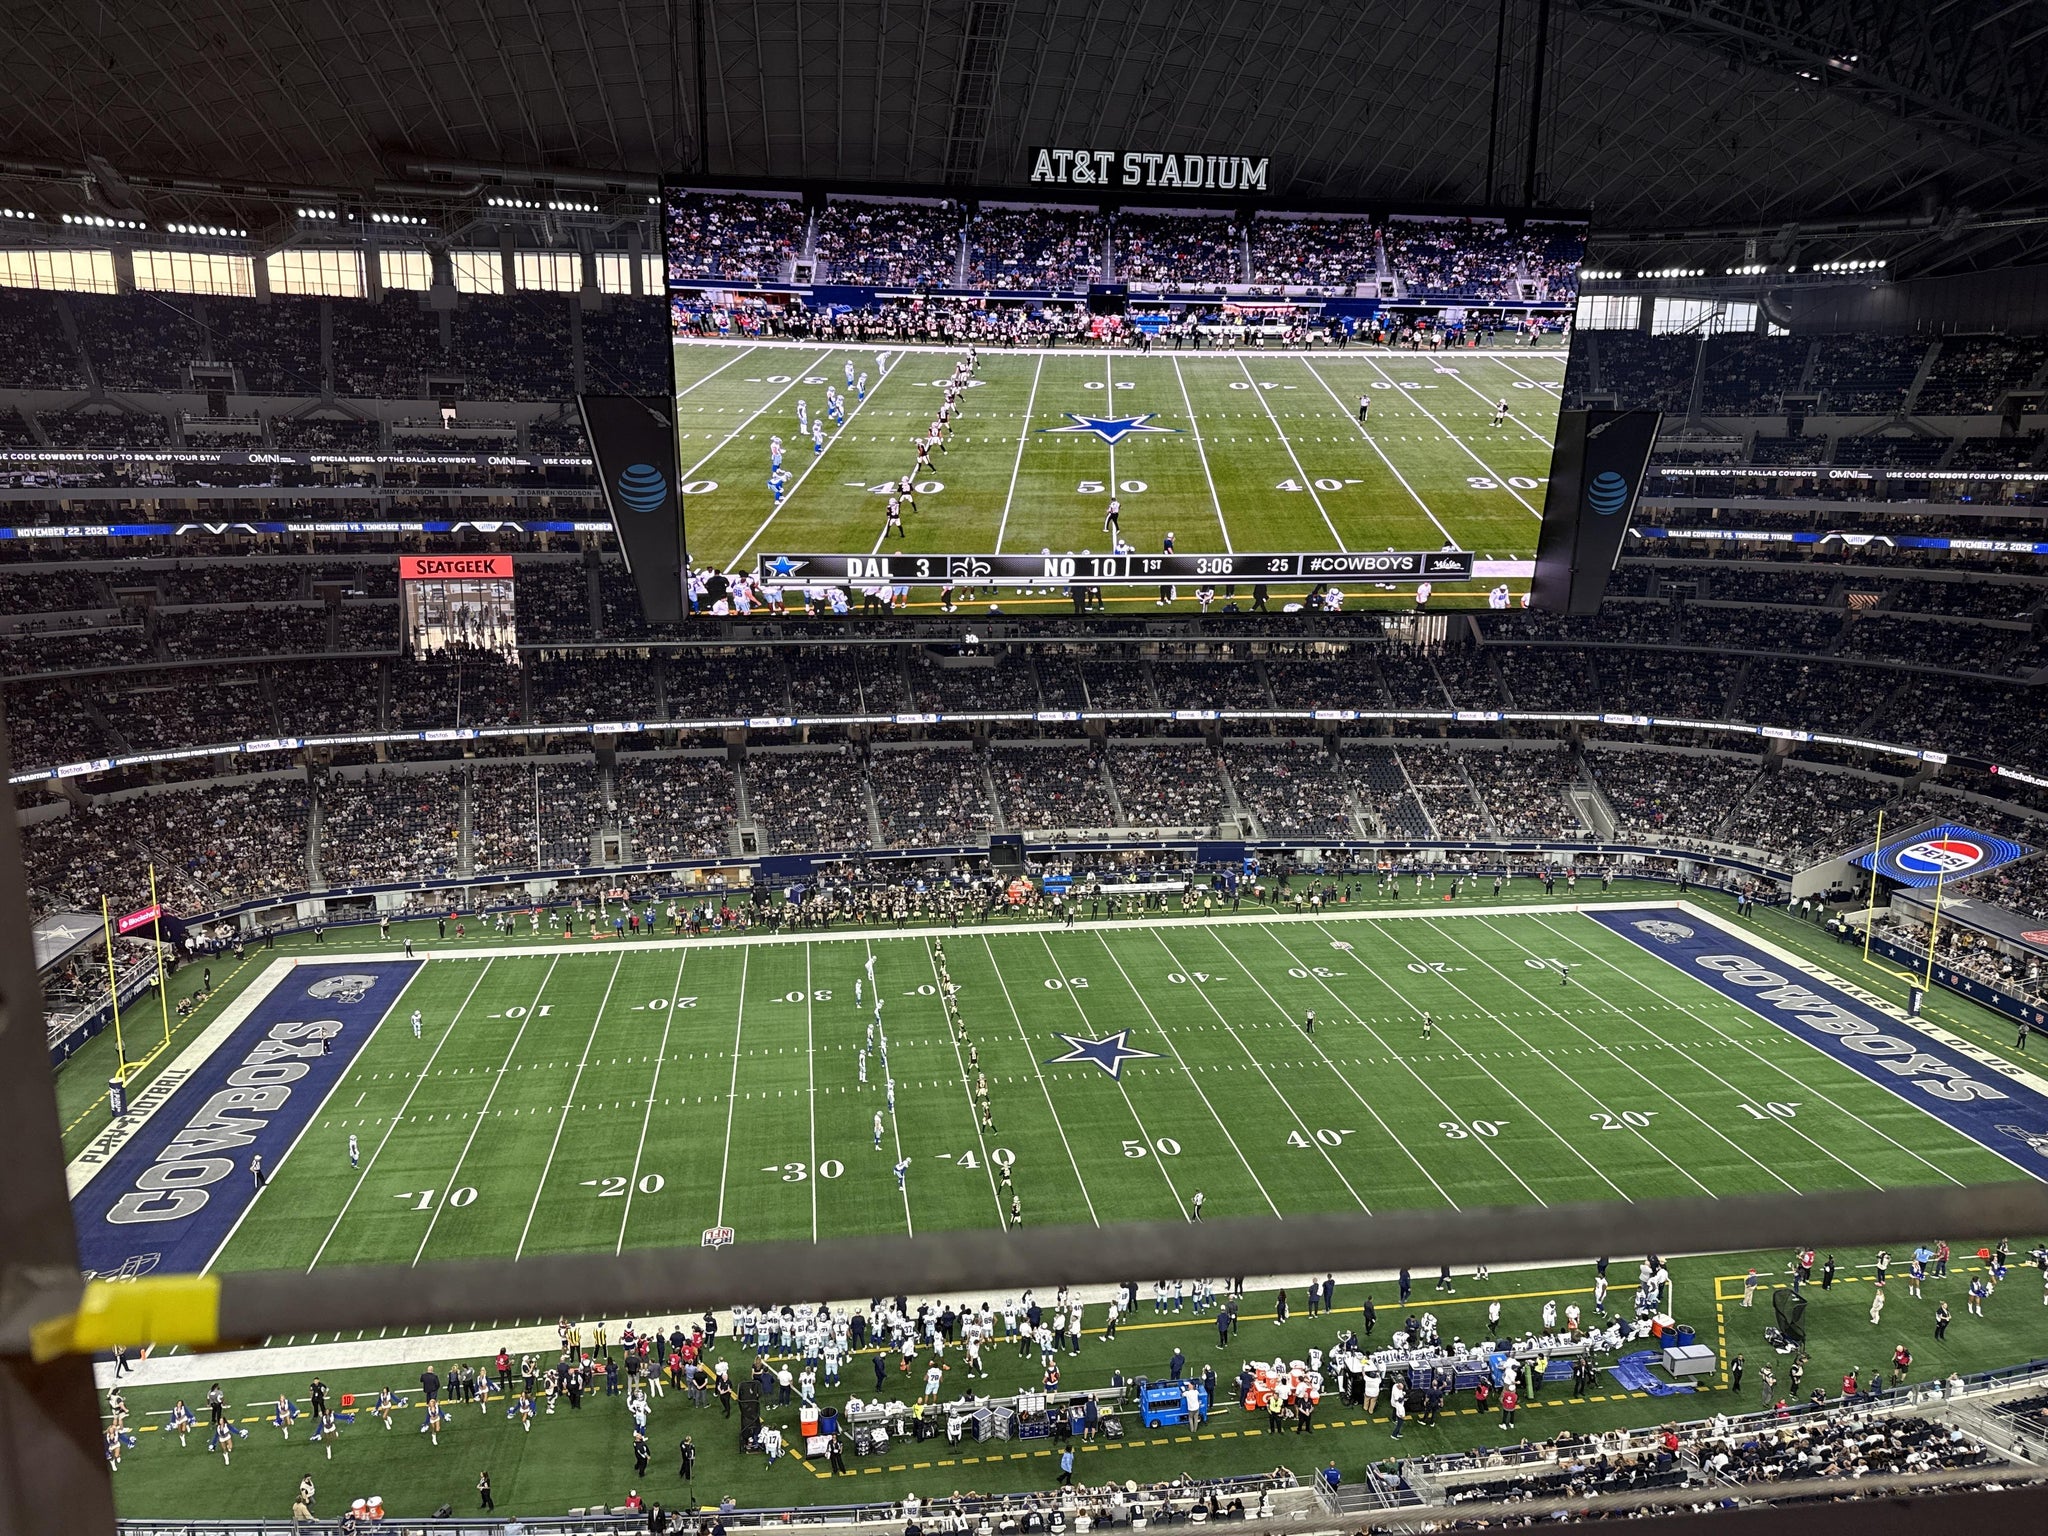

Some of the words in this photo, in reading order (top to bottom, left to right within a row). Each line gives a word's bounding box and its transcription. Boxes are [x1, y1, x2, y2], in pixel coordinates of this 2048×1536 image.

[1030, 149, 1115, 184] AT&T
[1122, 152, 1269, 190] STADIUM
[39, 453, 84, 461] COWBOYS
[249, 454, 279, 463] OMNI
[488, 456, 516, 465] OMNI
[1829, 469, 1858, 479] OMNI
[1077, 480, 1148, 493] 50
[1275, 479, 1343, 491] 40
[1466, 476, 1538, 489] 30
[18, 527, 65, 537] NOVEMBER
[68, 527, 83, 537] 22,
[85, 526, 109, 535] 2026
[574, 522, 613, 531] NOVEMBER
[1950, 540, 1993, 550] NOVEMBER
[1994, 542, 2008, 551] 22,
[416, 559, 497, 574] SEATGEEK
[848, 558, 894, 577] DAL
[916, 559, 930, 577] 3
[1044, 558, 1076, 577] NO
[1090, 559, 1116, 577] 10
[1143, 559, 1162, 574] 1ST
[1197, 558, 1233, 574] 3:06
[1267, 558, 1289, 572] :25
[1310, 557, 1413, 572] #COWBOYS
[60, 766, 83, 775] Tostitos
[1911, 845, 1970, 868] PEPSI
[1288, 966, 1334, 978] 30
[1407, 962, 1455, 974] 20
[1044, 977, 1089, 990] 50
[1167, 971, 1210, 984] 40
[648, 996, 698, 1011] 20
[785, 989, 833, 1003] 30
[505, 1004, 555, 1019] 10
[1799, 965, 1826, 976] IT
[1828, 977, 1894, 1010] TAKES
[1893, 1013, 1937, 1035] ALL
[1944, 1039, 1979, 1056] OF
[1983, 1059, 2024, 1075] US
[1695, 955, 2010, 1101] COWBOYS
[126, 1068, 192, 1124] FOOTBALL
[1736, 1102, 1793, 1120] 10
[106, 1020, 343, 1224] COWBOYS
[1590, 1110, 1650, 1130] 20
[1438, 1120, 1499, 1139] 30
[1286, 1128, 1343, 1147] 40
[1121, 1136, 1181, 1158] 50
[956, 1147, 1016, 1169] 40
[782, 1159, 845, 1182] 30
[598, 1173, 665, 1198] 20
[409, 1186, 479, 1211] 10
[707, 1229, 729, 1238] NFL
[1312, 1351, 1320, 1360] 31
[343, 1395, 351, 1407] 10
[851, 1403, 860, 1412] 56
[768, 1436, 777, 1445] 17
